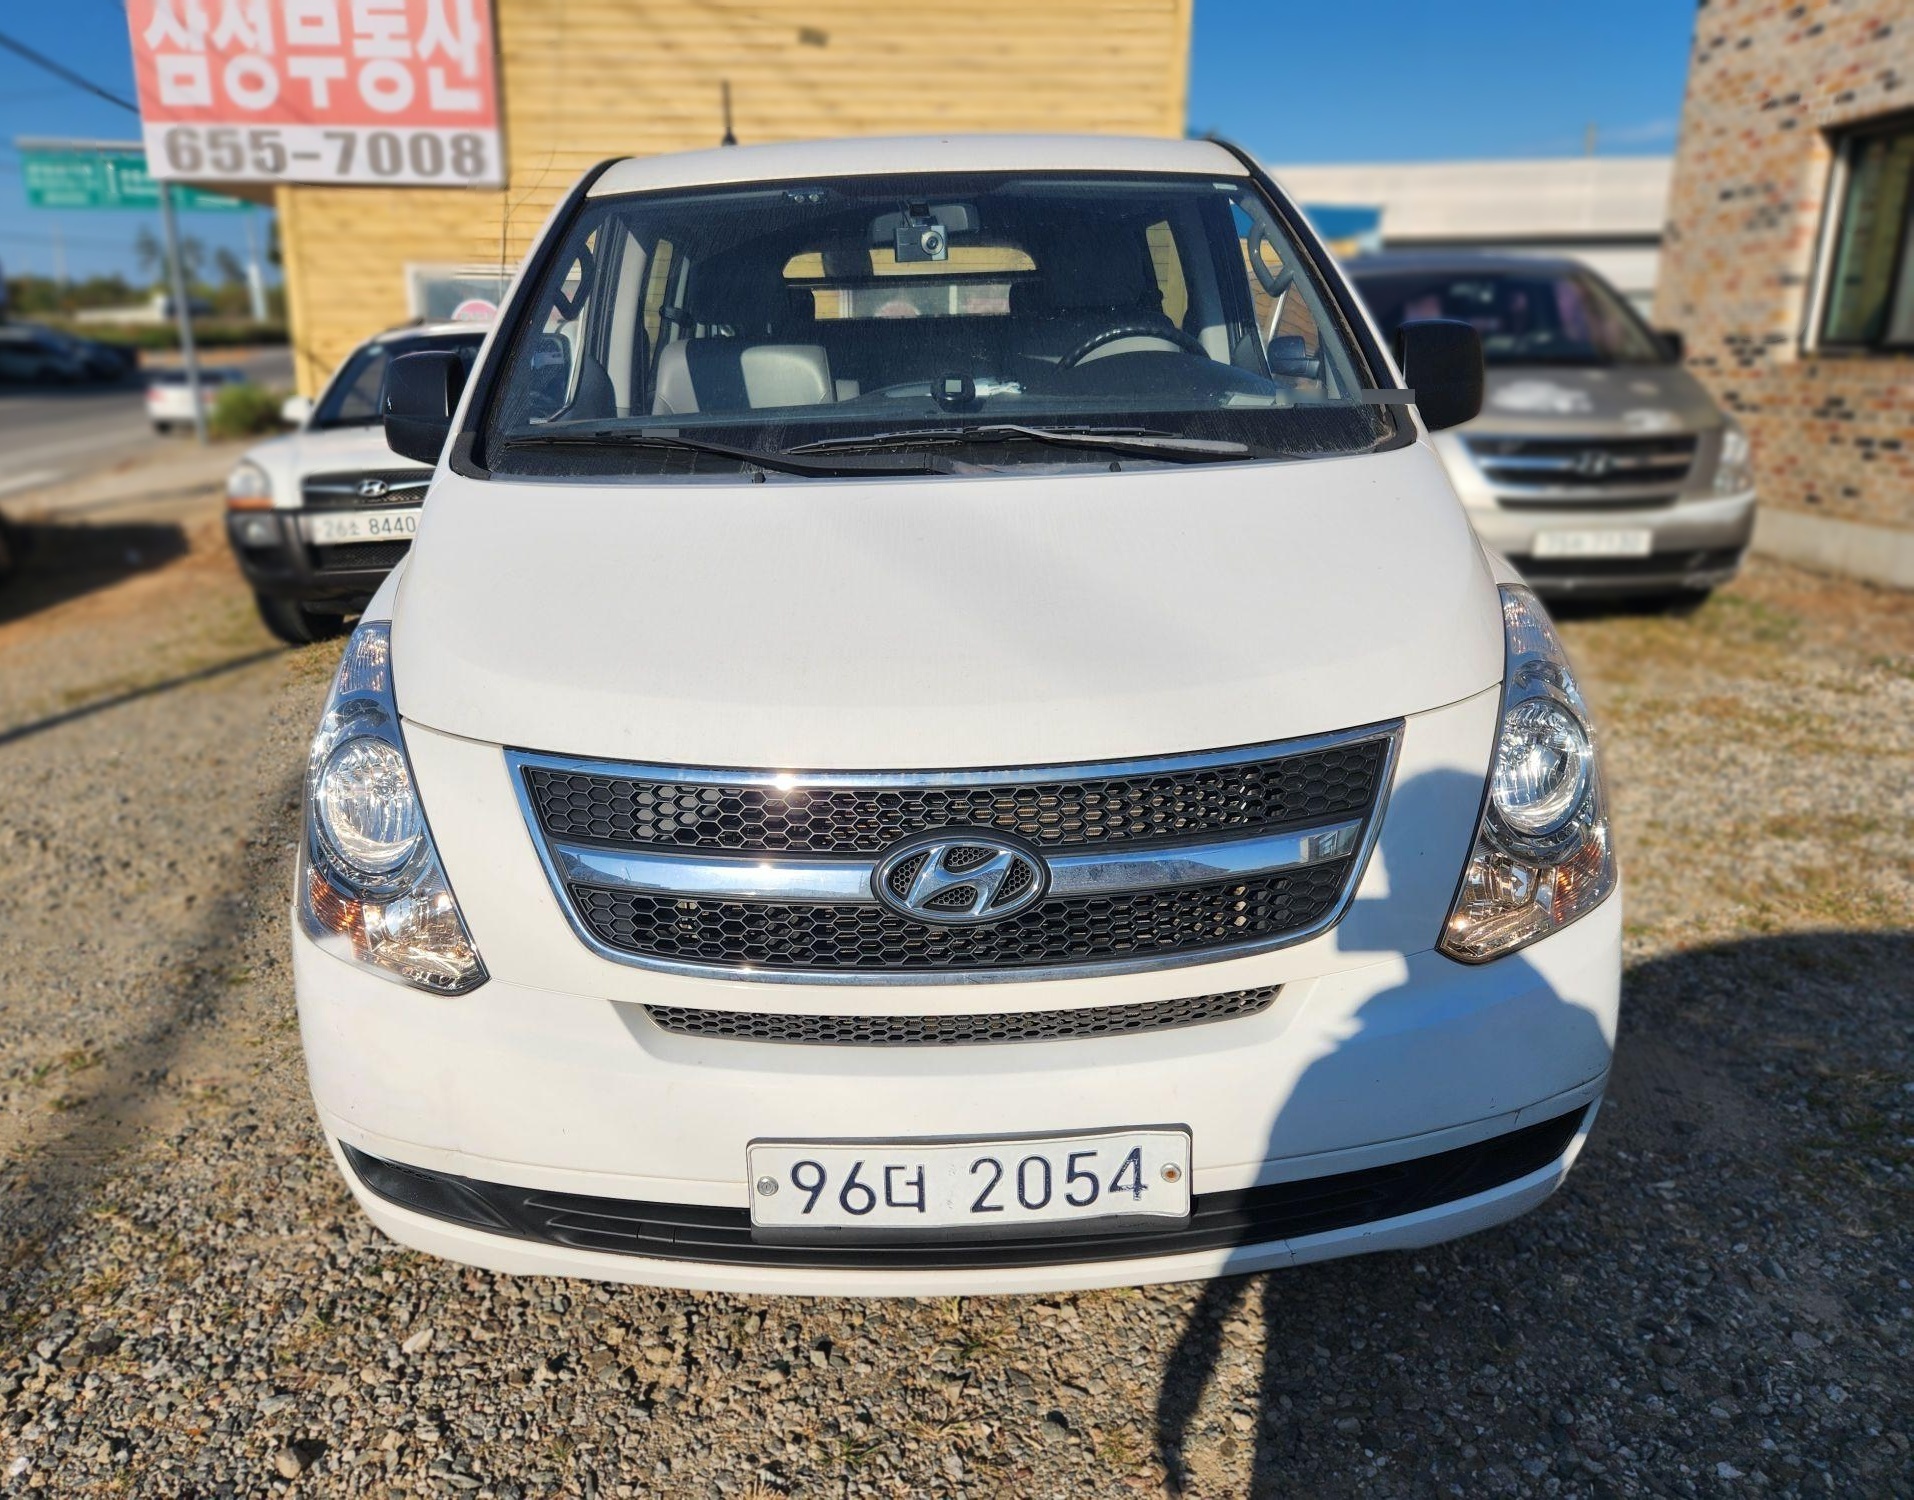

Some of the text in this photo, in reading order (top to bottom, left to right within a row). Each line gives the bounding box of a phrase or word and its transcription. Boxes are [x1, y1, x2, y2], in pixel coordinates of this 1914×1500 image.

[164, 127, 487, 178] 655-7008
[369, 516, 416, 535] 8440
[790, 1145, 1149, 1215] 96더 2054
